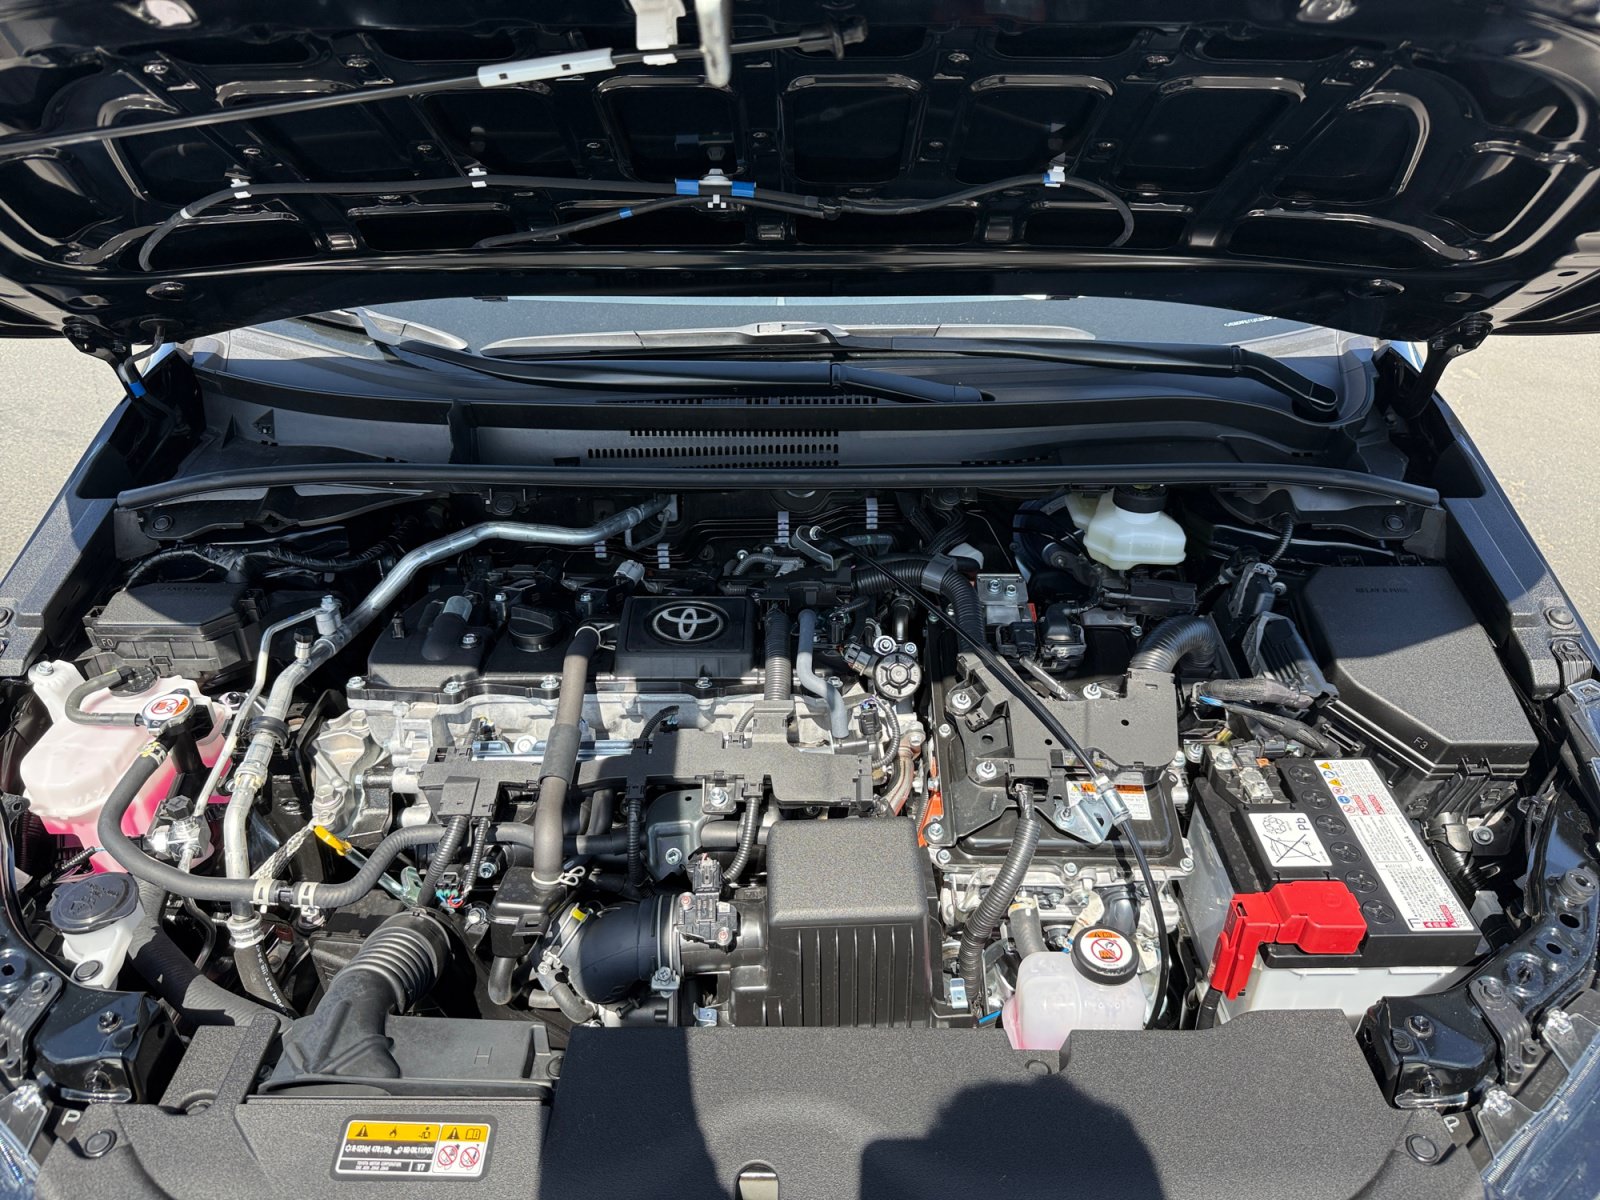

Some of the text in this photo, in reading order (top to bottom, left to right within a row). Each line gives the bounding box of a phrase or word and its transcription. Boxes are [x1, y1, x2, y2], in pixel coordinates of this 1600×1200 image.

[1296, 817, 1311, 831] Pb
[61, 1109, 81, 1126] P
[1443, 1116, 1460, 1133] P
